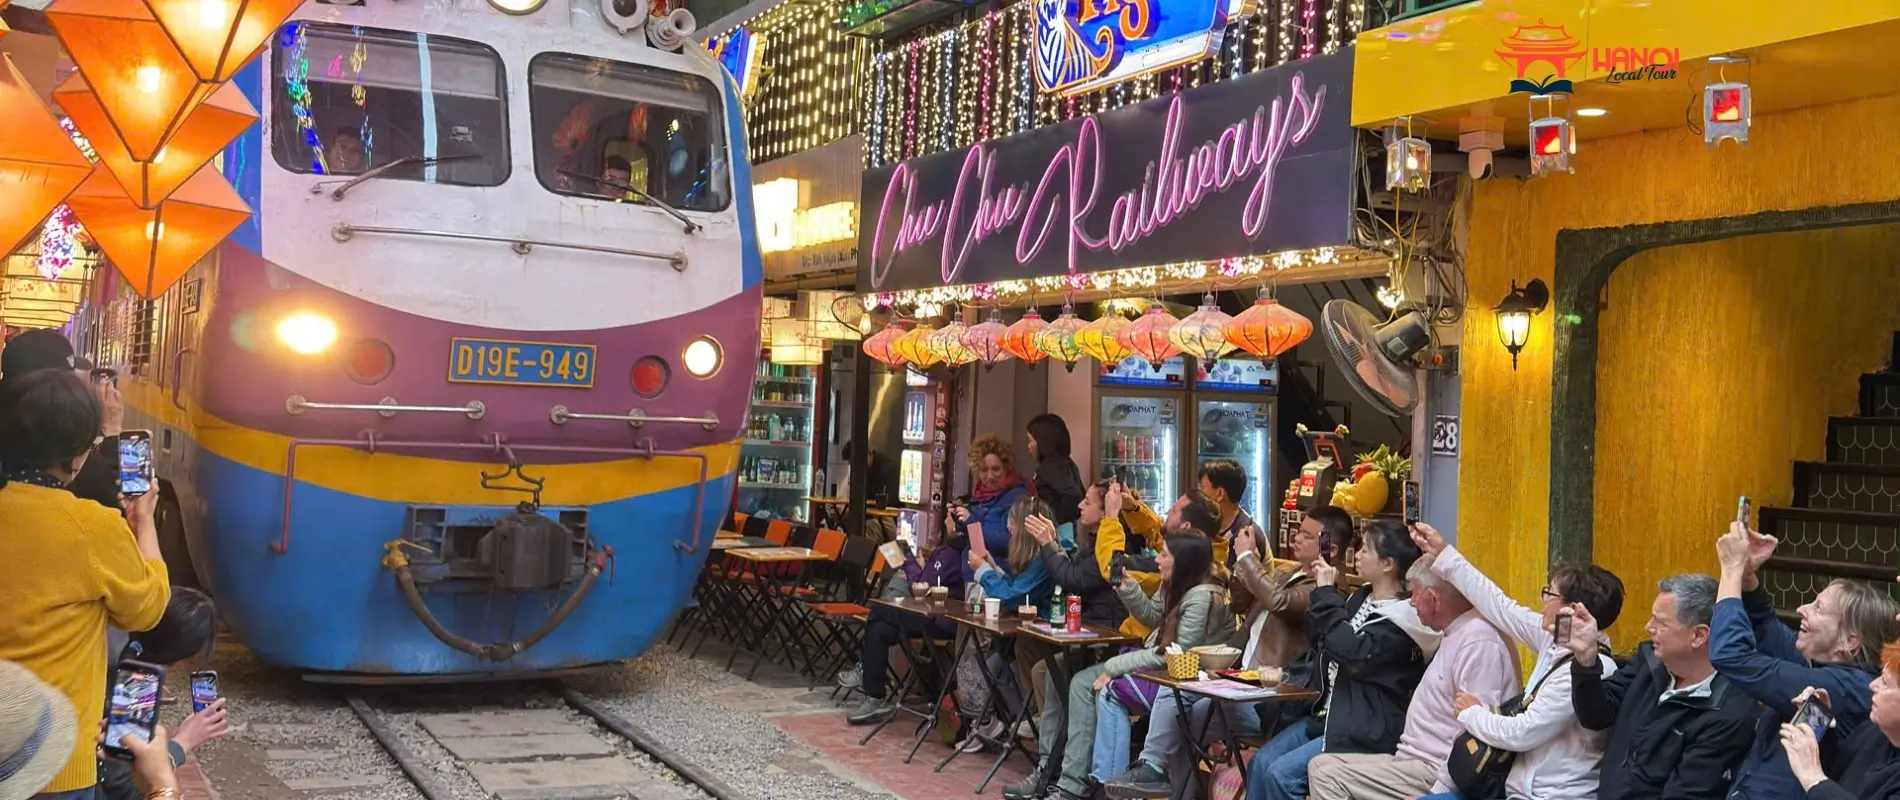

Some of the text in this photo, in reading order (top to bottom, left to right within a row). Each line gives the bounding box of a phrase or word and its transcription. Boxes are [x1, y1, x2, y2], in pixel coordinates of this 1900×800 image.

[872, 160, 947, 289] Chu
[941, 143, 1029, 285] Chu
[1016, 71, 1327, 274] Railways
[457, 345, 588, 380] D19E-949
[1433, 420, 1458, 450] 28
